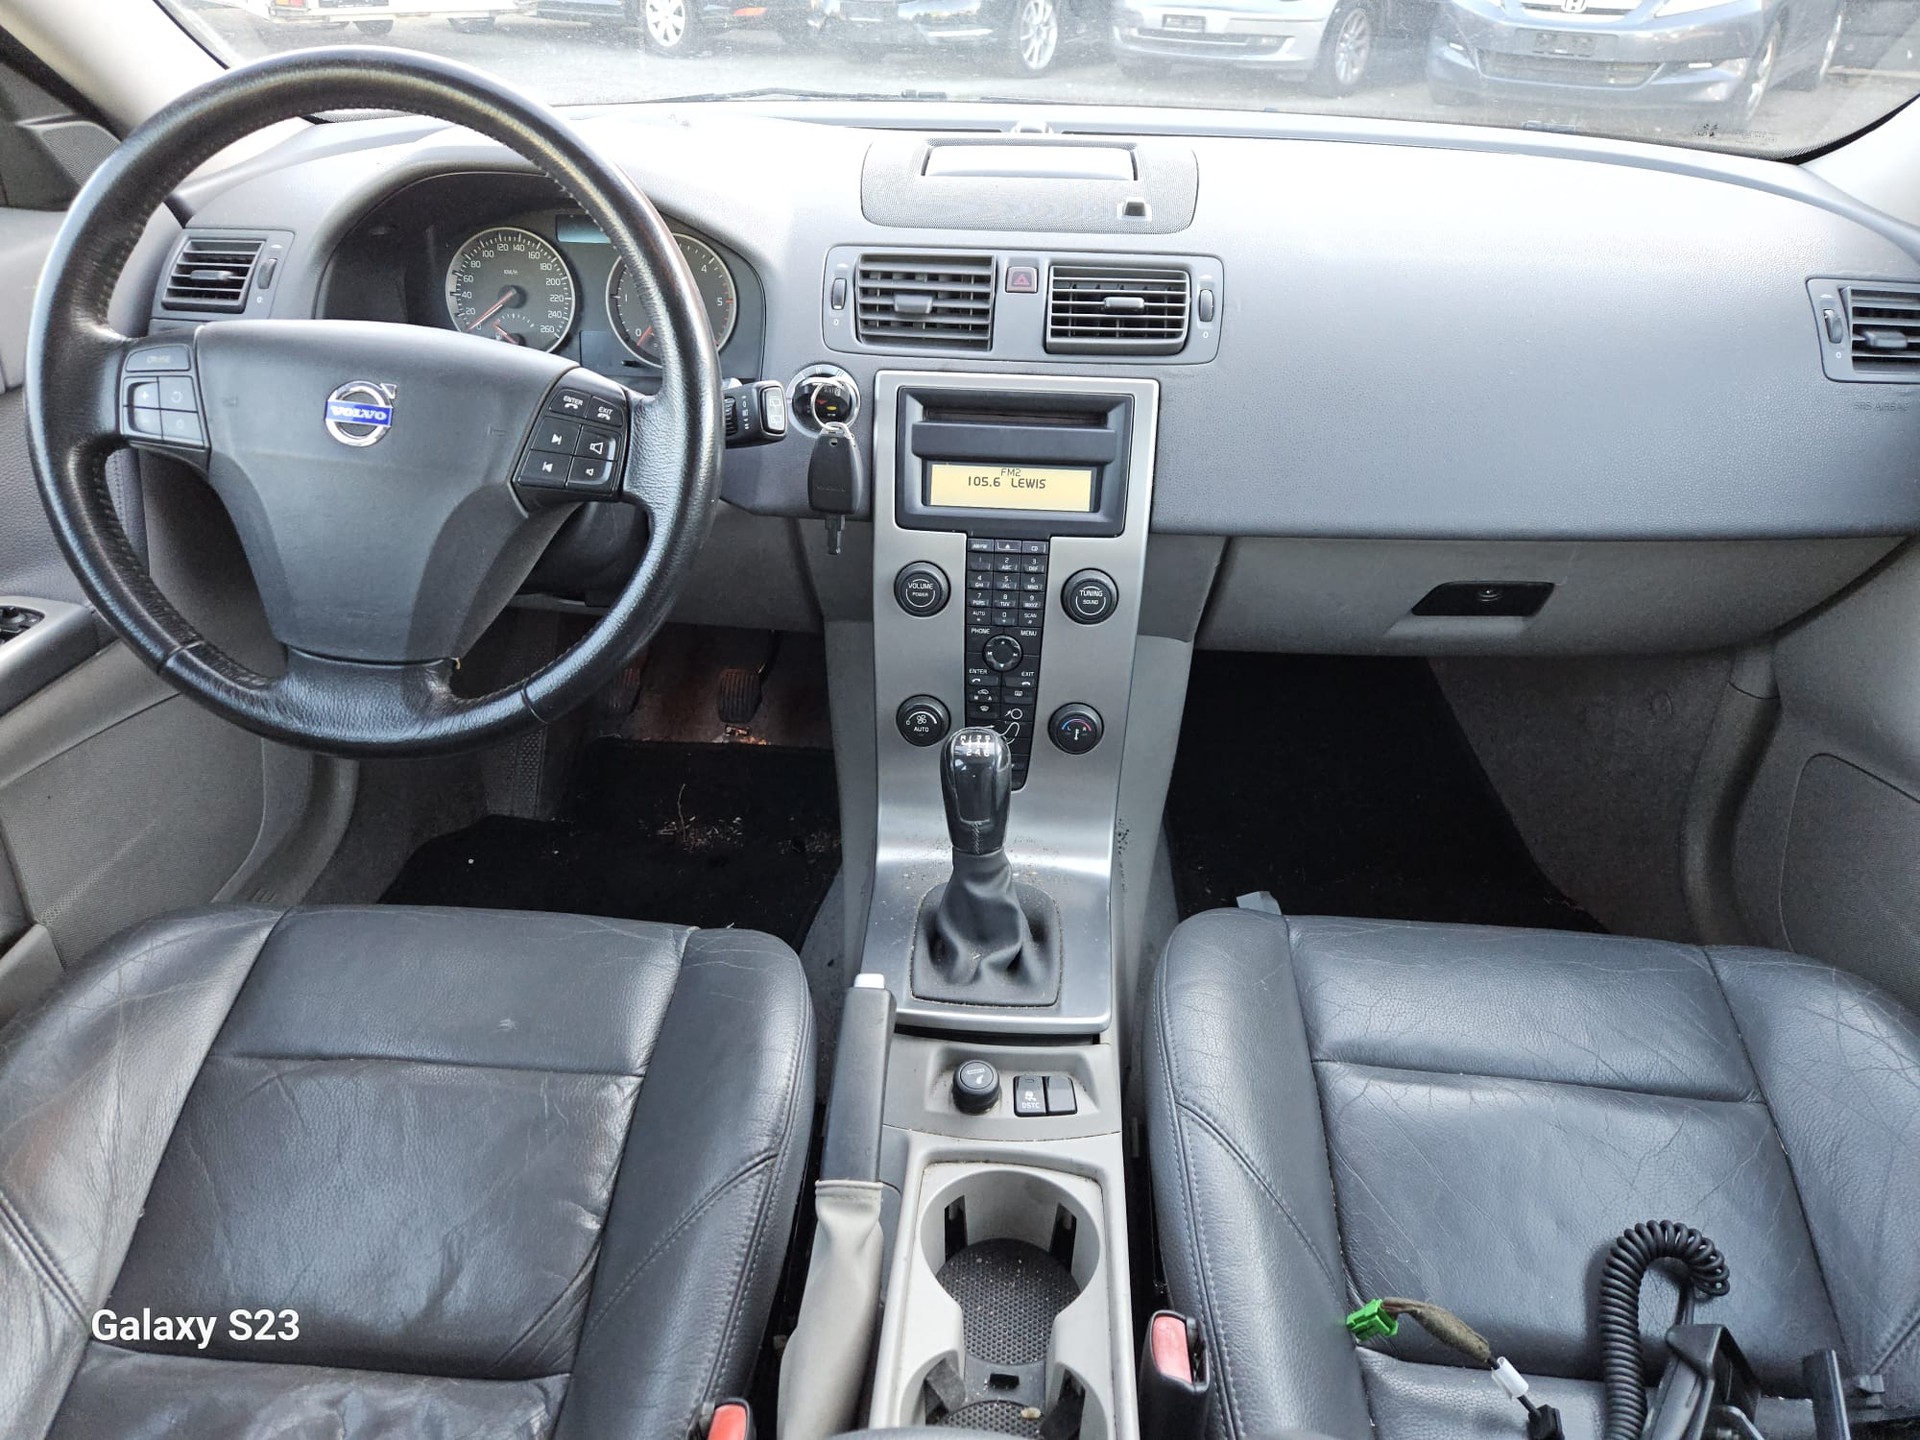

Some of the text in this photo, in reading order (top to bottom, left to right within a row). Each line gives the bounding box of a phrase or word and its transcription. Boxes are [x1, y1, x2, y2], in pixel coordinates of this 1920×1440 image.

[497, 243, 509, 251] 120
[513, 244, 525, 252] 140
[482, 250, 495, 258] 100
[528, 252, 541, 260] 160
[470, 260, 481, 268] 80
[540, 262, 553, 270] 180
[701, 264, 707, 272] 4
[463, 275, 474, 283] 60
[545, 277, 561, 286] 200
[461, 291, 473, 299] 40
[549, 294, 565, 303] 220
[717, 297, 723, 306] 5
[465, 307, 476, 315] 20
[547, 311, 563, 319] 240
[635, 328, 642, 337] 0
[563, 395, 584, 406] ENTER
[330, 405, 387, 421] VOLVO
[598, 406, 613, 415] EXIT
[1000, 468, 1022, 477] FM2
[968, 476, 1047, 489] 105.6 LEWIS
